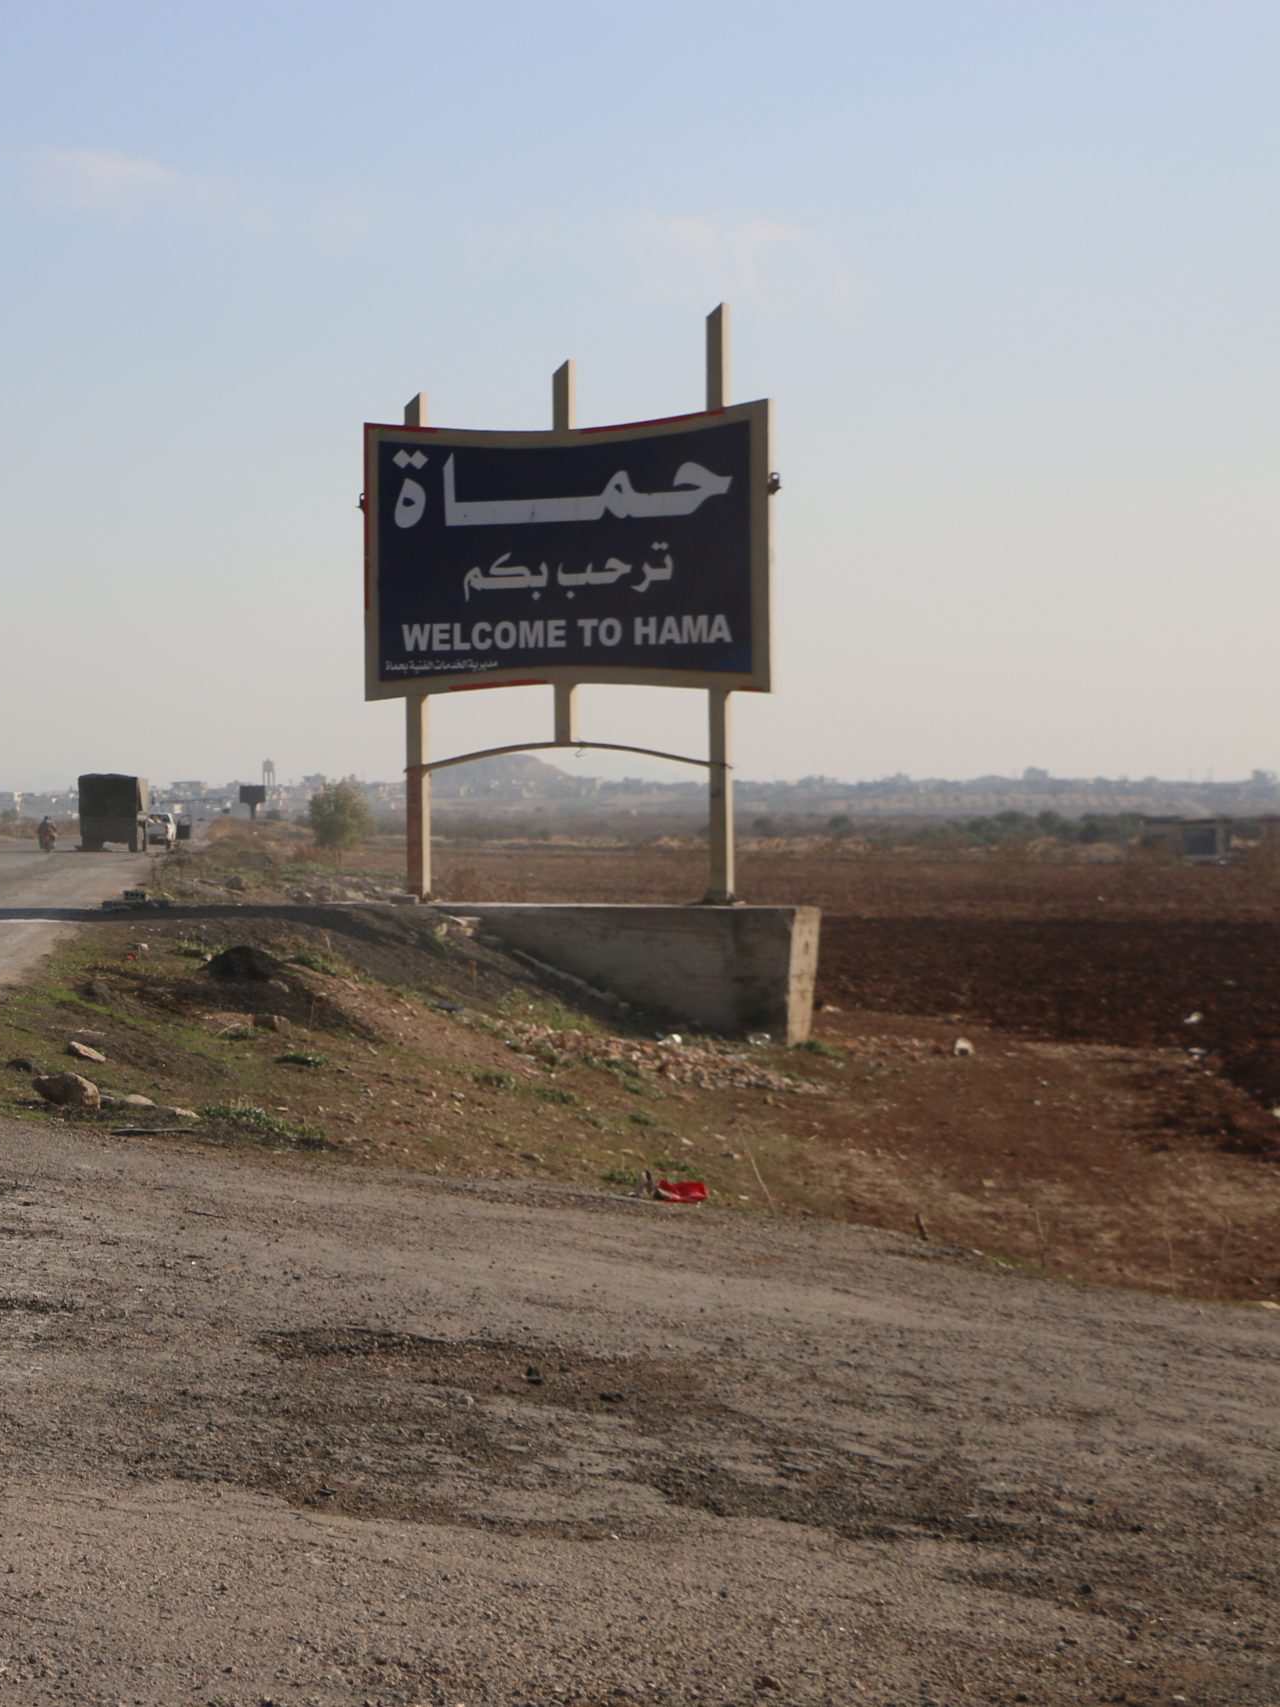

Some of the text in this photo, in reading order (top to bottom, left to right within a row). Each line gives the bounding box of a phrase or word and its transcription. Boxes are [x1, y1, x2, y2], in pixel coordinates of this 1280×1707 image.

[464, 541, 673, 603] ترحب بكم
[402, 614, 732, 652] WELCOME TO HAMA
